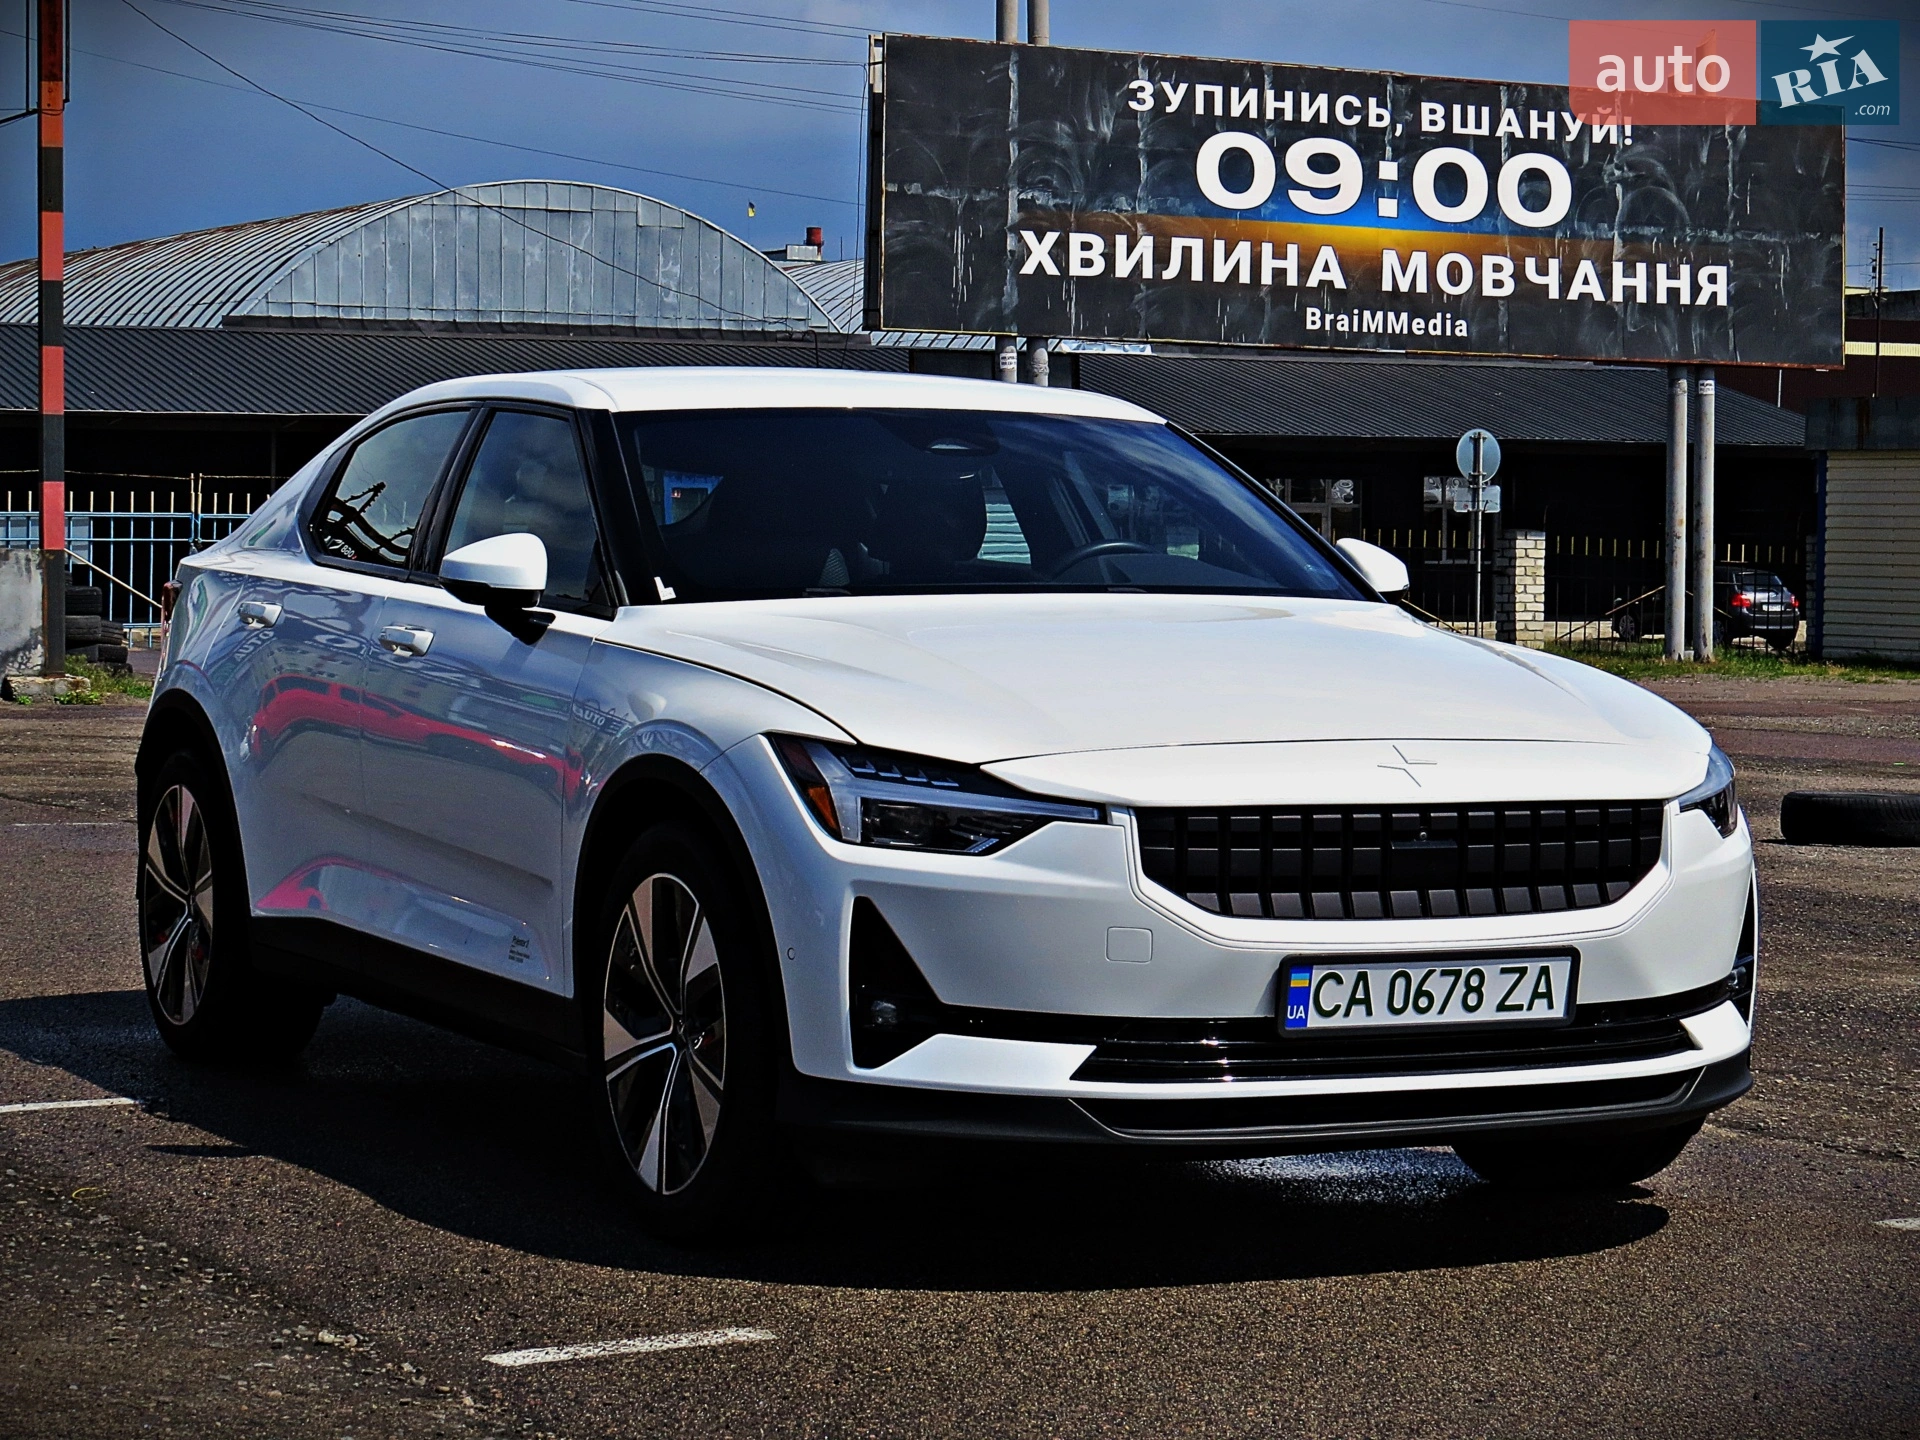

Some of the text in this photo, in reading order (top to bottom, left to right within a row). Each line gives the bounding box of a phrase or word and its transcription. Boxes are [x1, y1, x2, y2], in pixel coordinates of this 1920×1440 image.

[1128, 79, 1633, 146] ЗУПИНИСЬ, ВШАНУЙ!
[1196, 131, 1573, 228] 09:00
[1019, 230, 1729, 307] ХВИЛИНА МОВЧАННЯ
[1305, 307, 1469, 338] BraiMMedia
[1287, 1005, 1306, 1020] UA
[1312, 965, 1555, 1018] CA 0678 ZA
